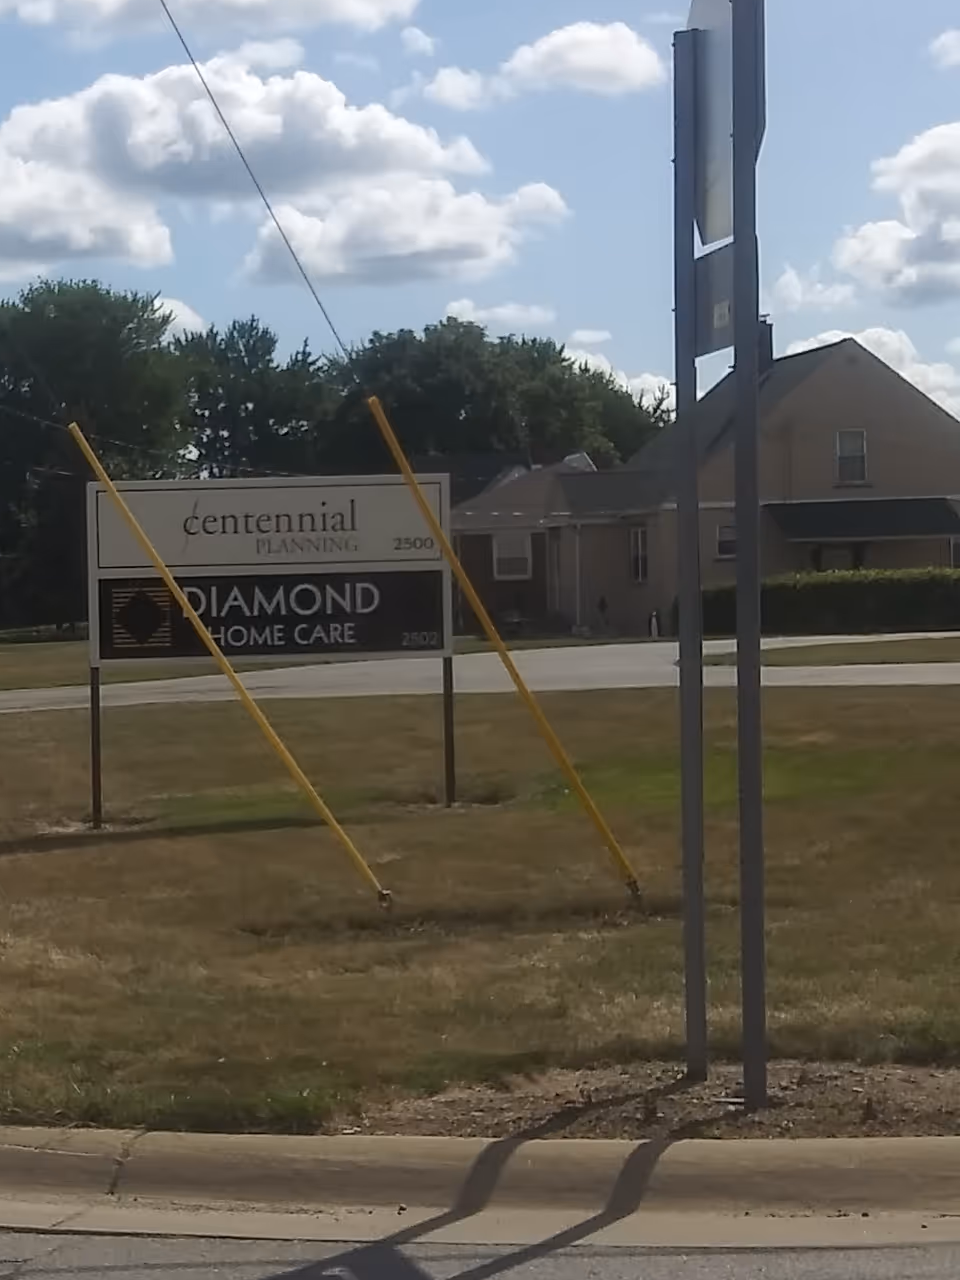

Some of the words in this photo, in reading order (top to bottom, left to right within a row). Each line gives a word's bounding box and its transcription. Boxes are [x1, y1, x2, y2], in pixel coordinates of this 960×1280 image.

[182, 498, 359, 539] centennial
[256, 535, 359, 555] PLANNING
[393, 537, 434, 551] 2500
[183, 582, 380, 618] DIAMOND
[210, 624, 286, 648] HOME
[294, 622, 357, 645] CARE
